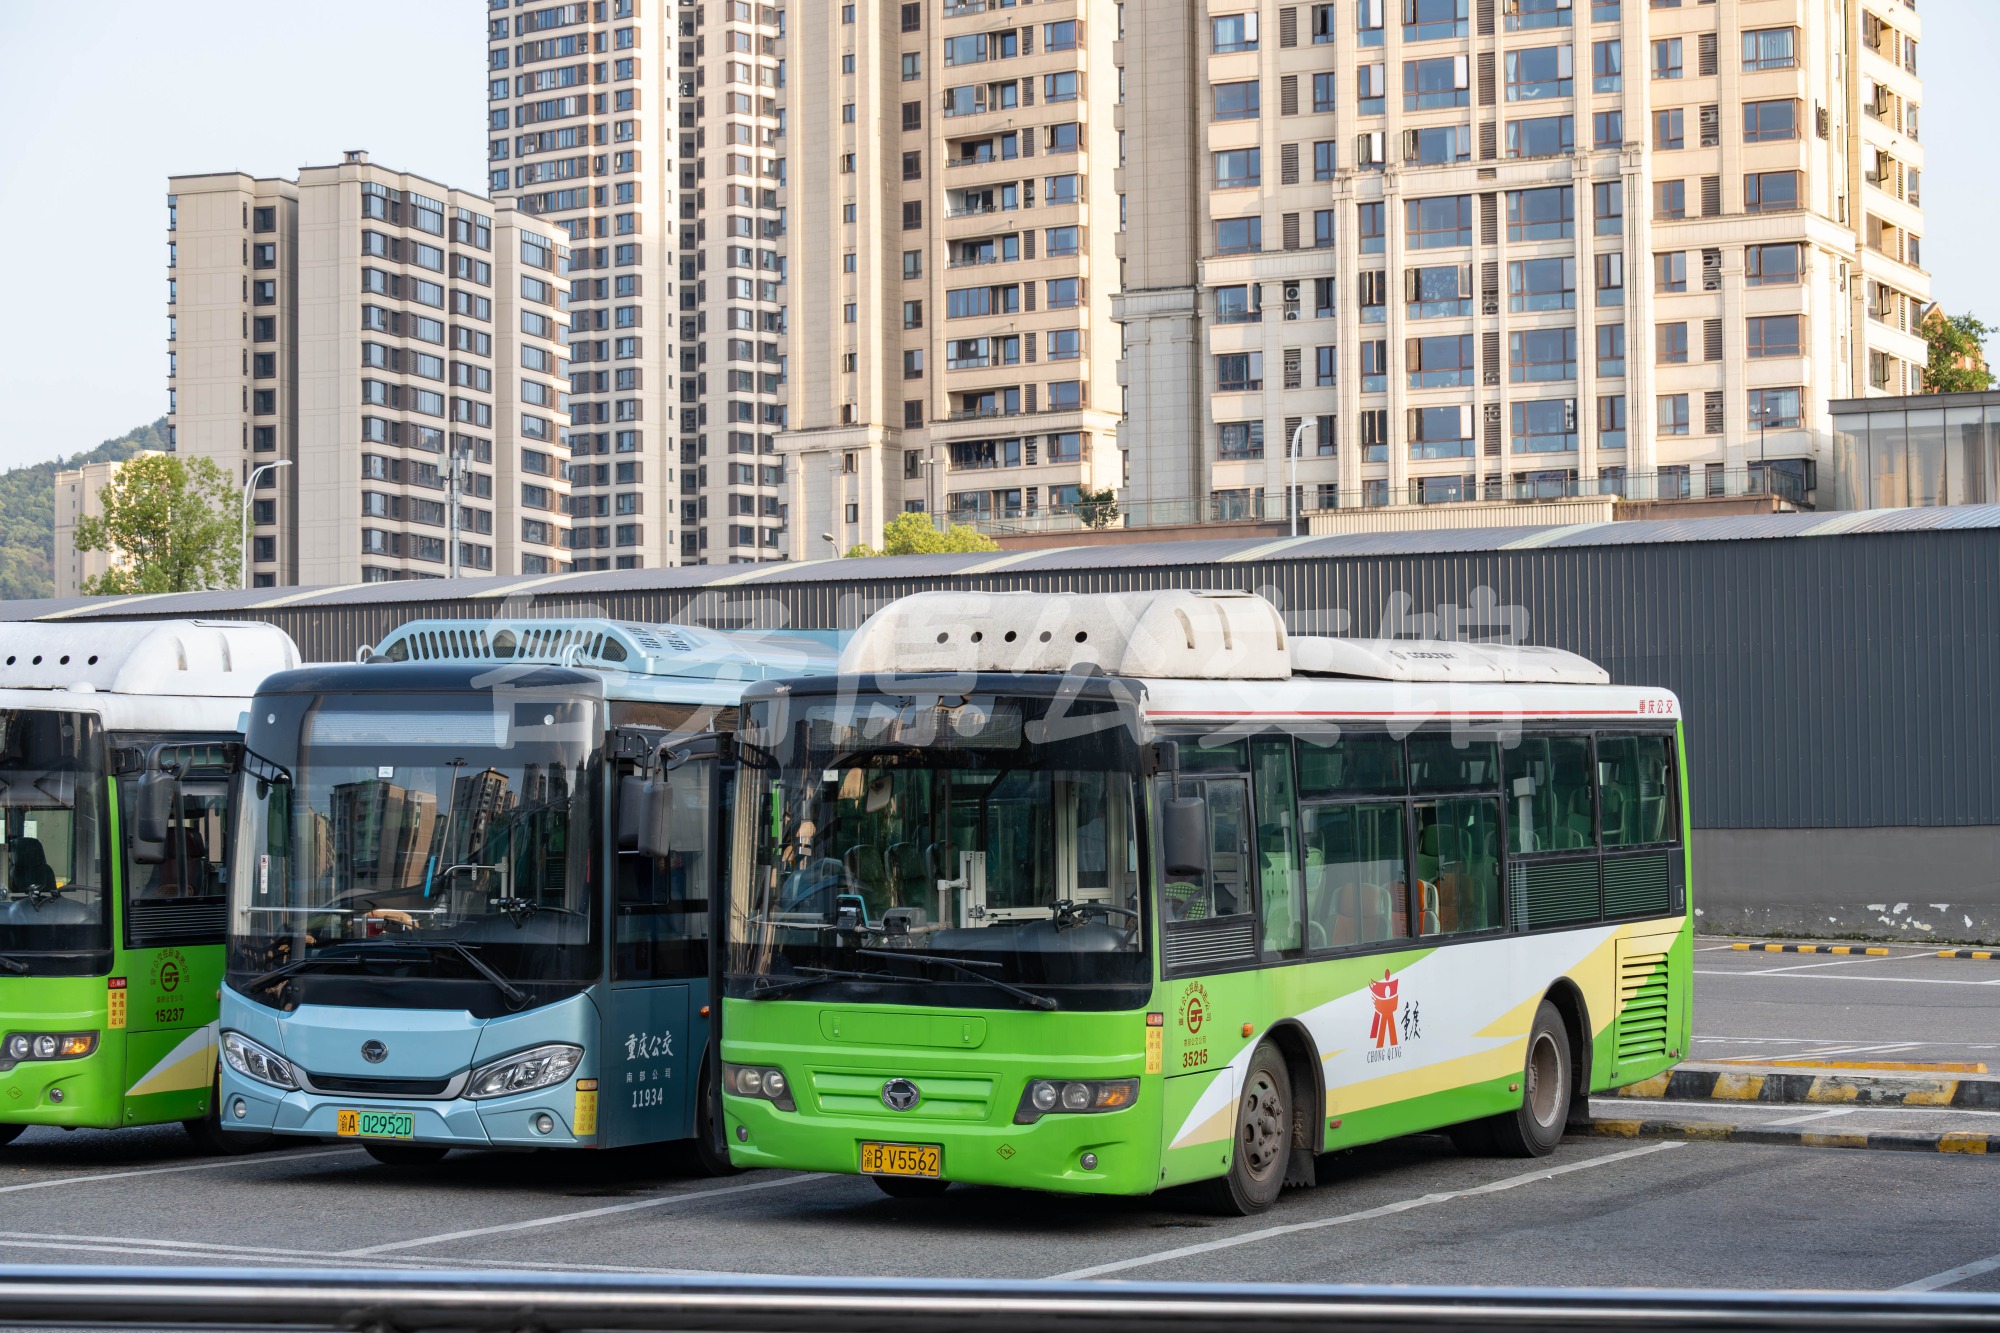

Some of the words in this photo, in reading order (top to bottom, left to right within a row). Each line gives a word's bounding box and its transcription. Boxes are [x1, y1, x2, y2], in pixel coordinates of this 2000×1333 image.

[1638, 699, 1673, 714] 重庆公交
[155, 1008, 185, 1023] 15237
[624, 1029, 674, 1061] 重庆公交
[1182, 1048, 1208, 1069] 35215
[1366, 1048, 1386, 1064] CHONG
[1387, 1046, 1402, 1061] QING
[626, 1067, 671, 1083] 南部公司
[631, 1087, 663, 1108] 11934
